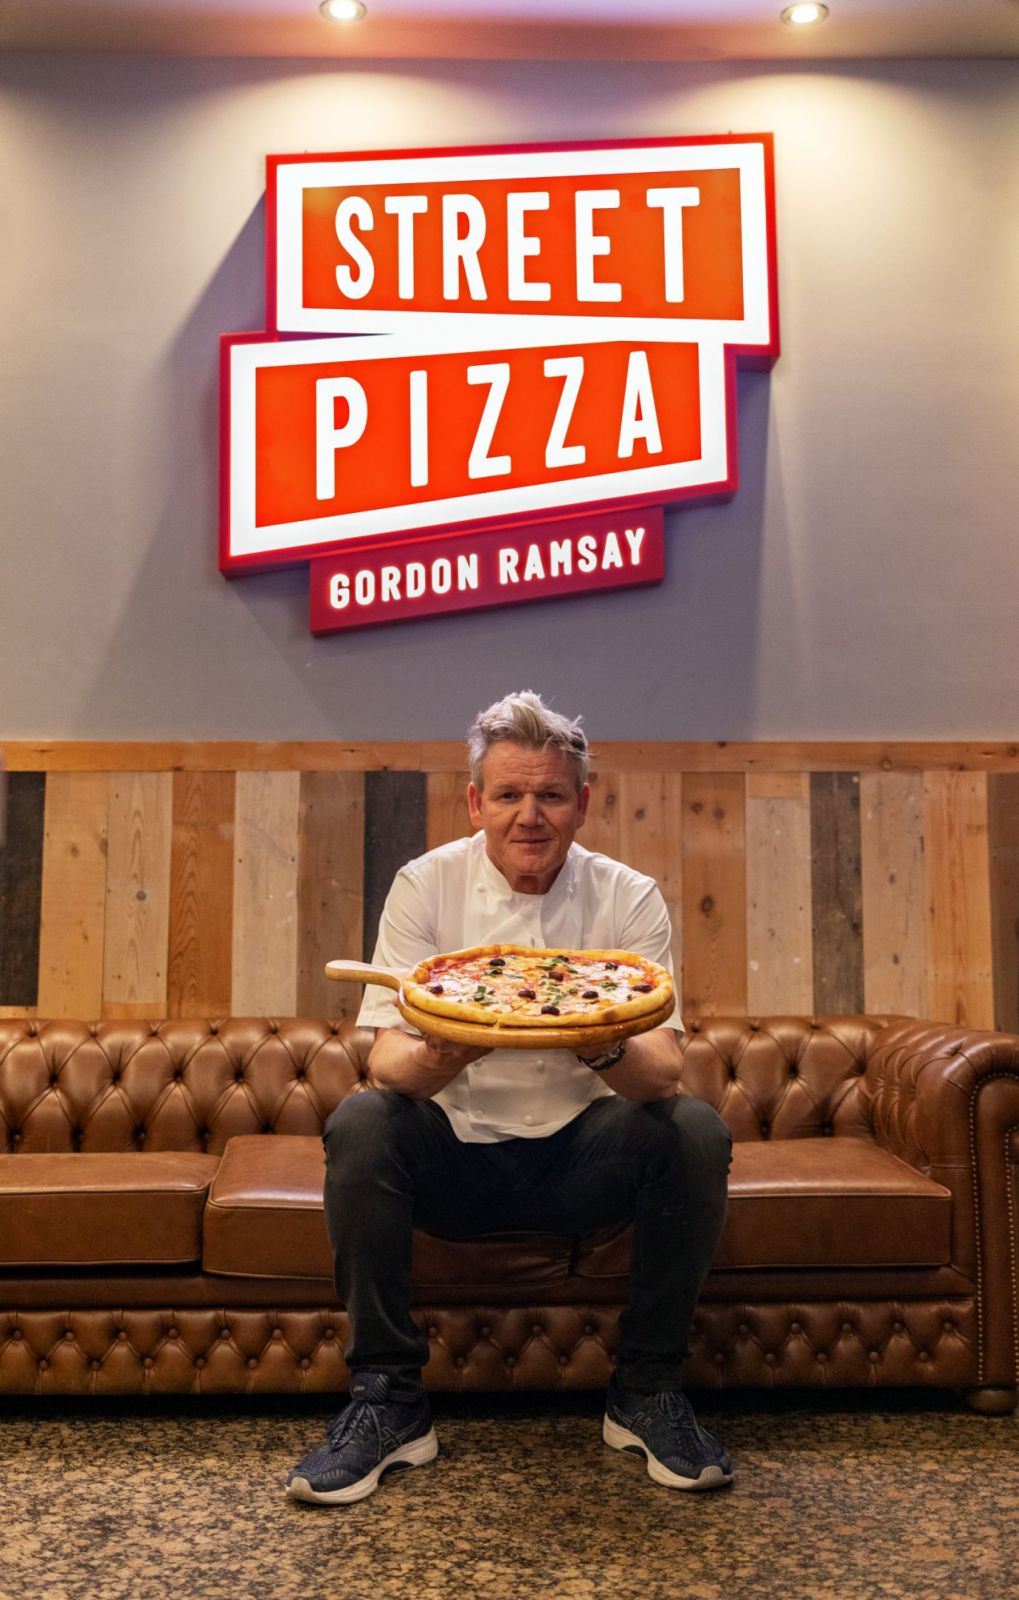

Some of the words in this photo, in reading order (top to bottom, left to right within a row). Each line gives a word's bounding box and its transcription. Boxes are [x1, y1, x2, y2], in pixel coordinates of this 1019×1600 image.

[335, 187, 700, 303] STREET
[316, 351, 663, 500] PIZZA
[330, 554, 478, 609] GORDON
[499, 528, 645, 585] RAMSAY
